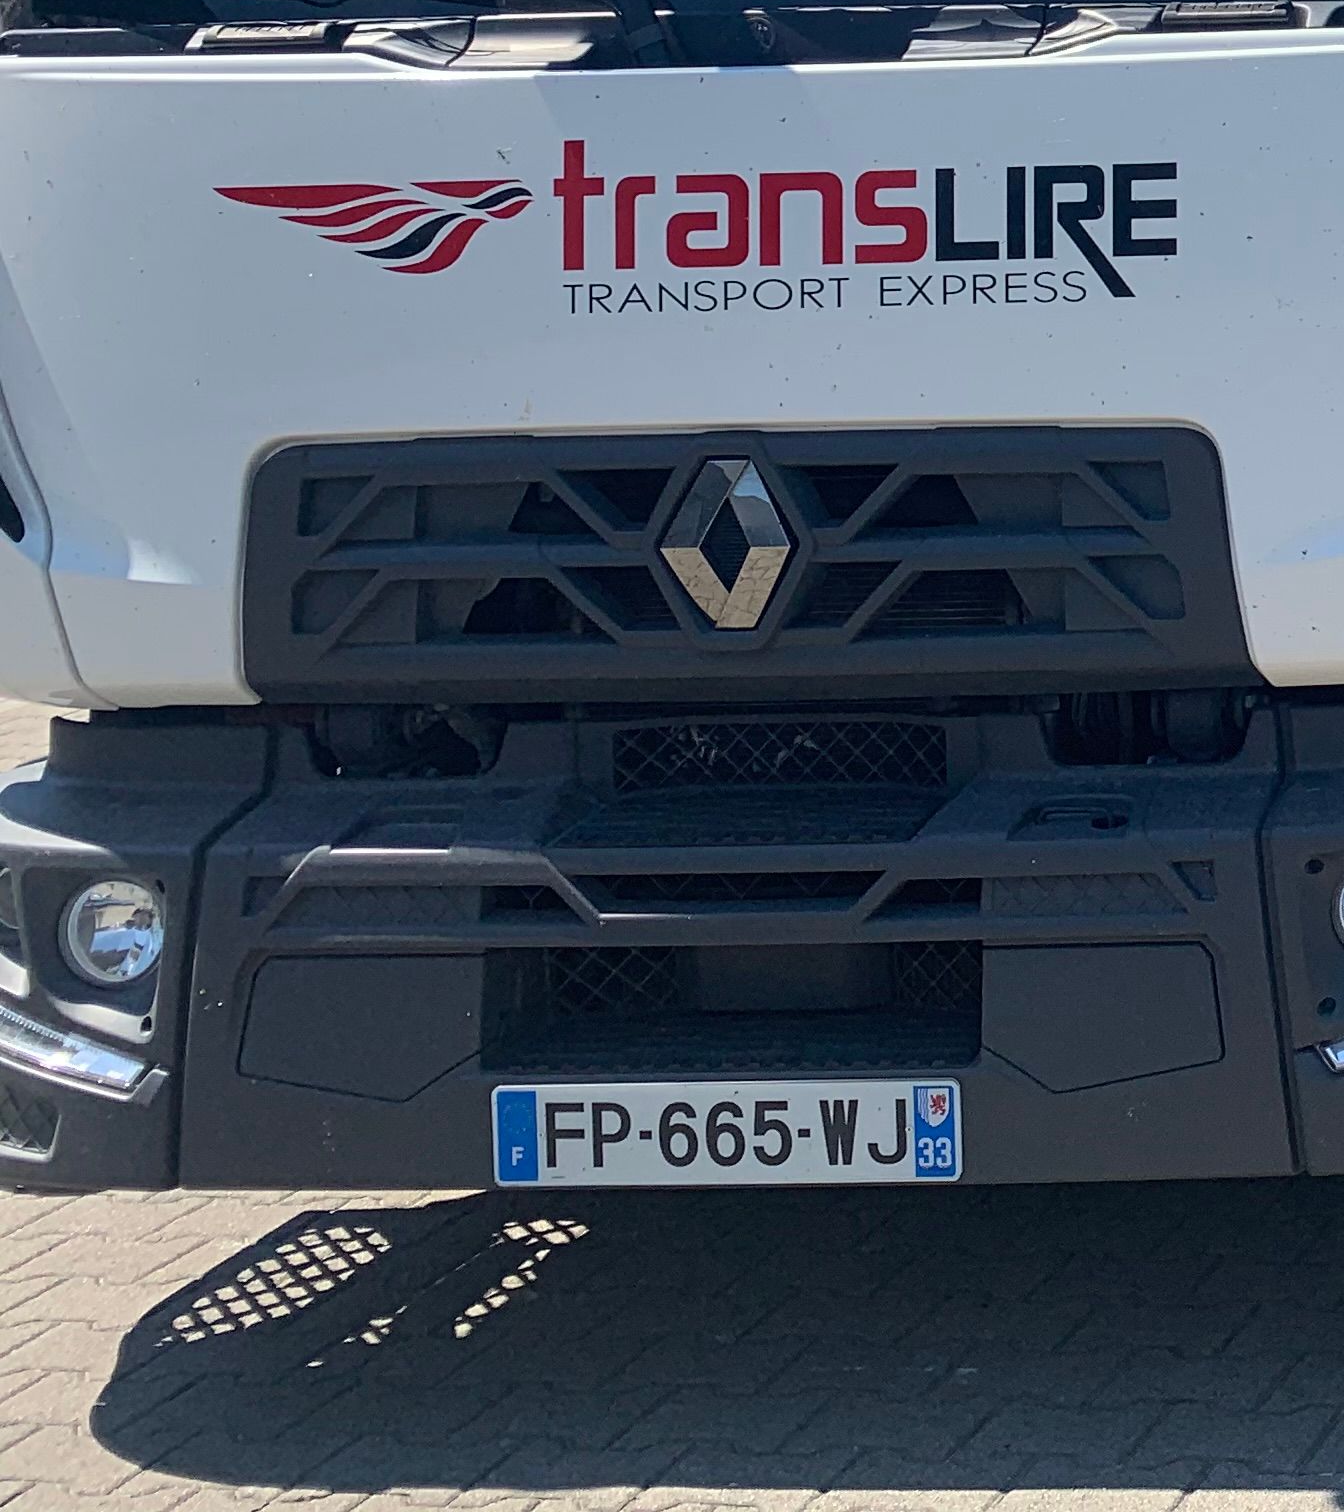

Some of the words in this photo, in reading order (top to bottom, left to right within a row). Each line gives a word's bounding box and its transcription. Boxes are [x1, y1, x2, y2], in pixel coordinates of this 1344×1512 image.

[562, 277, 849, 314] TRANSPORT
[879, 271, 1087, 306] EXPRESS
[511, 1146, 525, 1167] F
[544, 1098, 908, 1169] FP-665-WJ
[917, 1137, 954, 1170] 33
